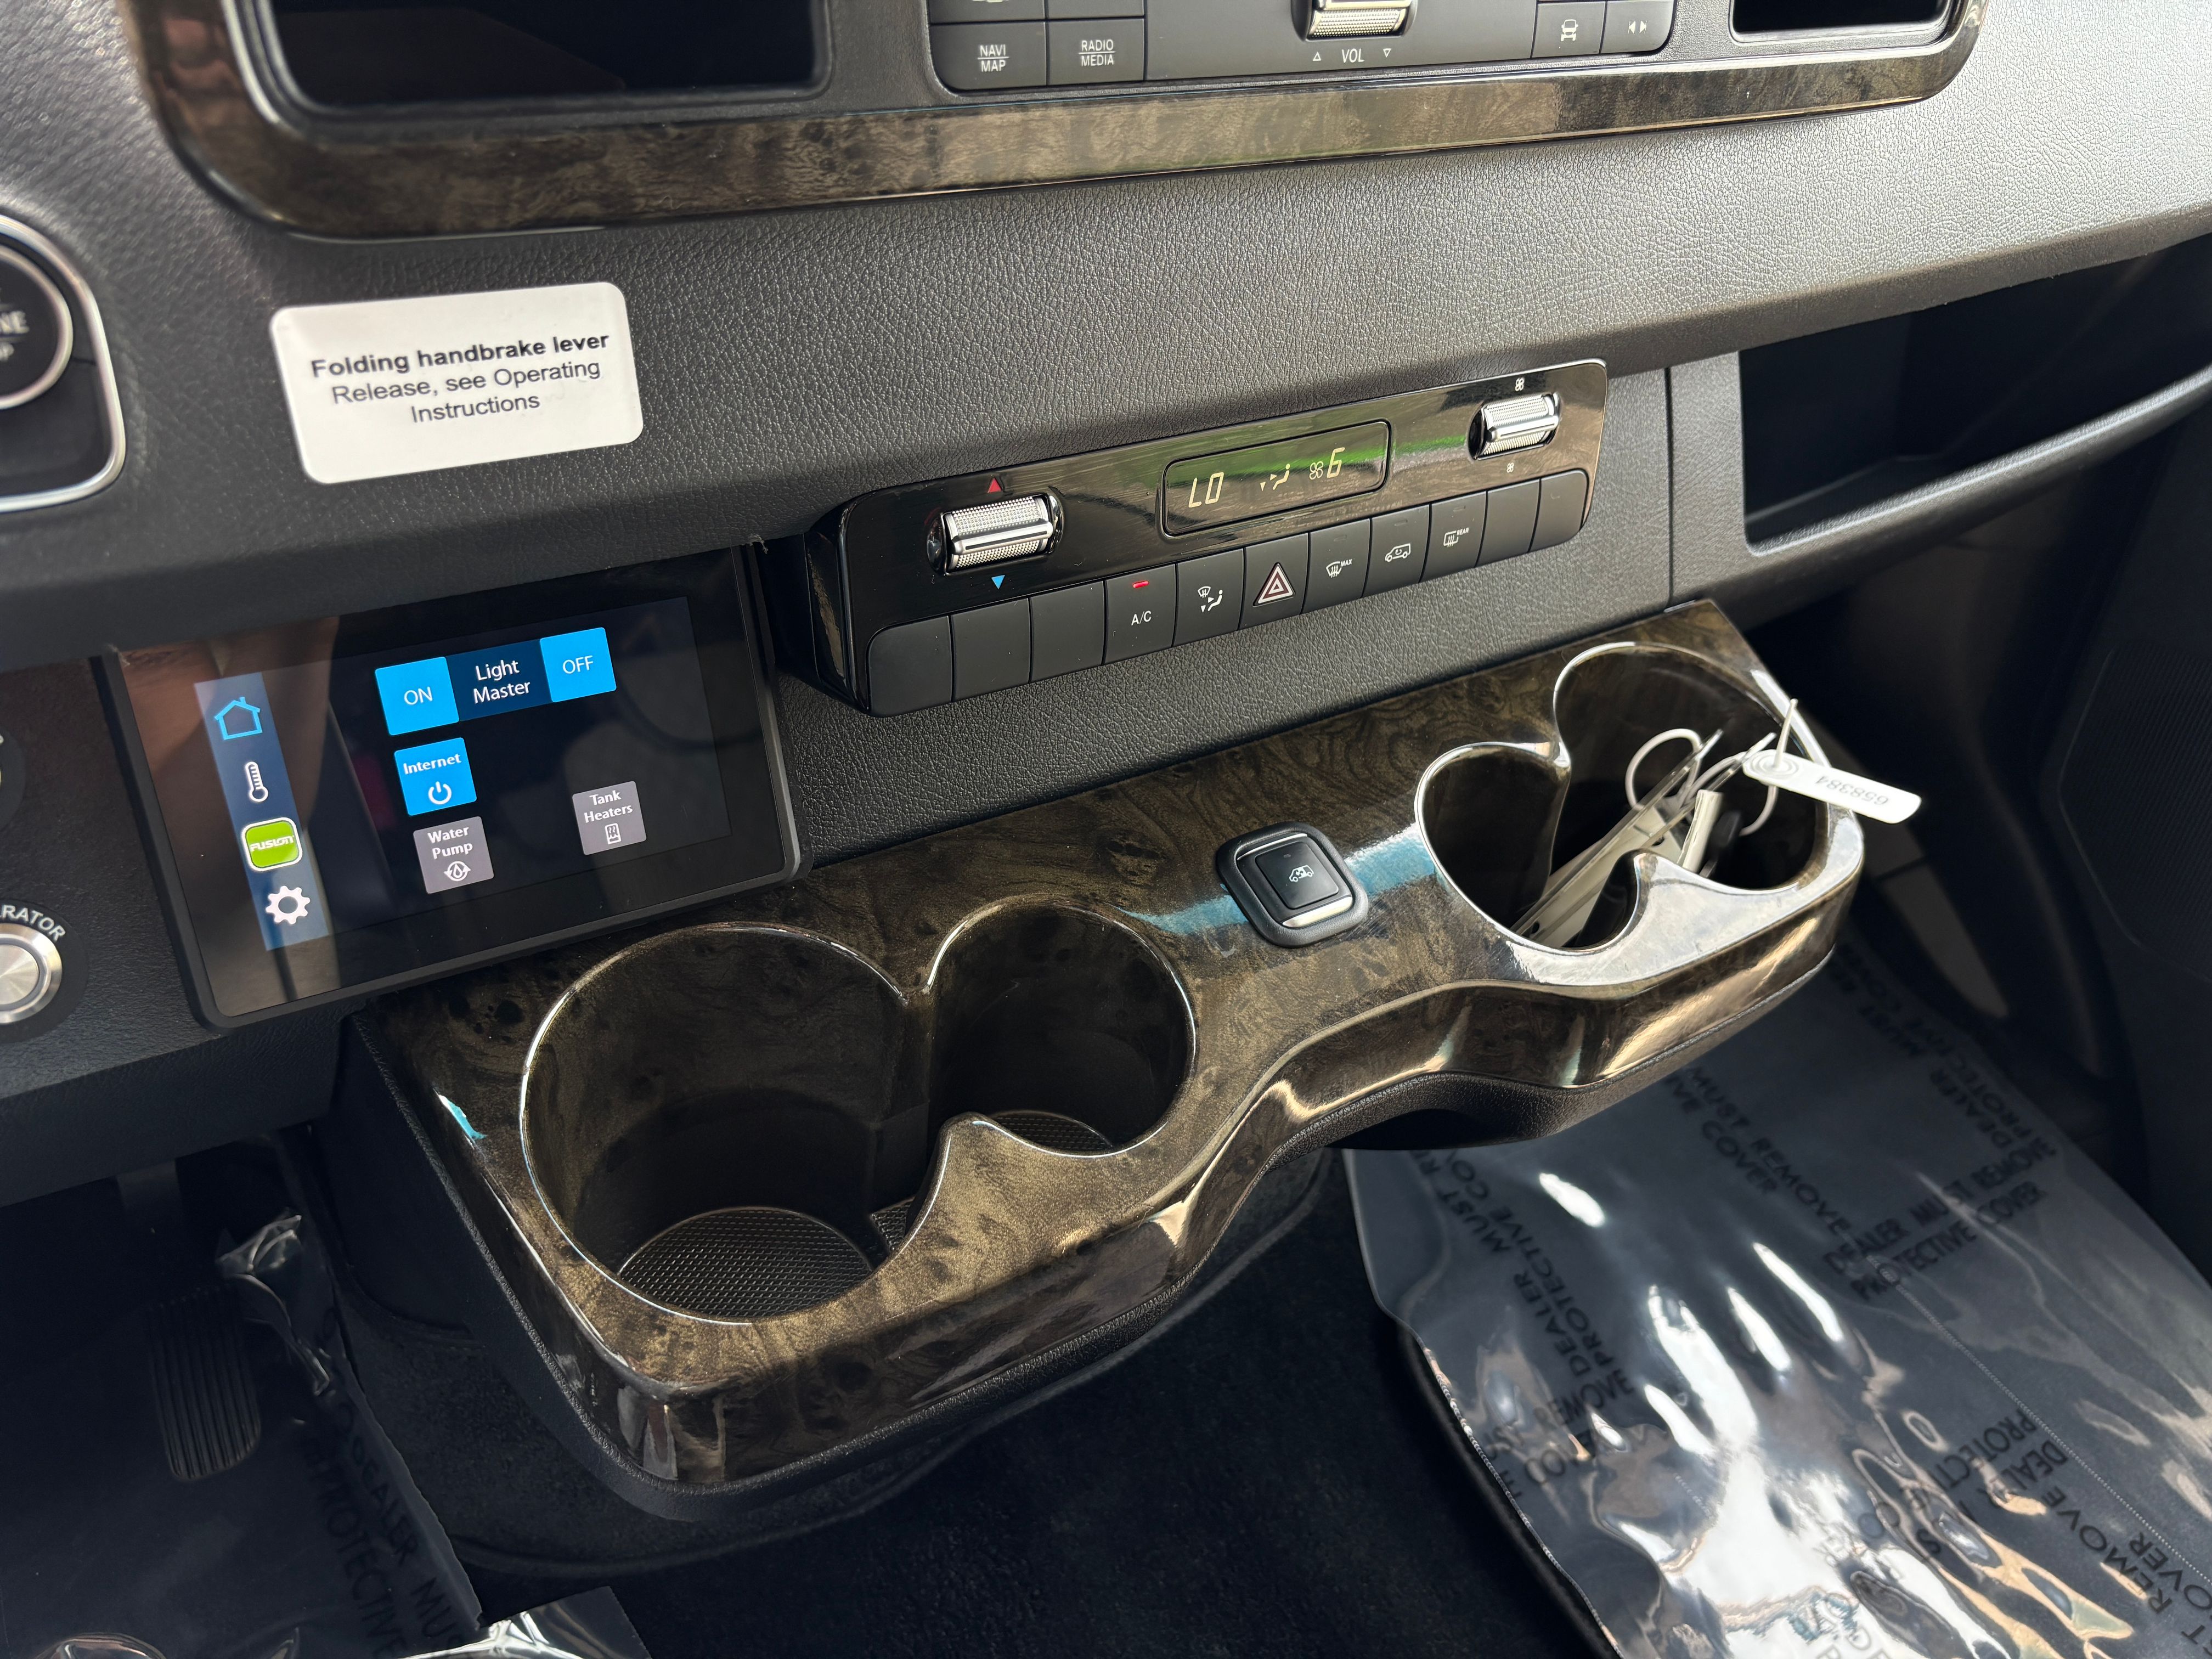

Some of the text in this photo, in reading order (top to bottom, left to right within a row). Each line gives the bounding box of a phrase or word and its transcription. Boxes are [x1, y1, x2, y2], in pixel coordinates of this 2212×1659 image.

[979, 44, 1006, 57] NAVI
[1081, 39, 1114, 52] RADIO
[981, 60, 1006, 72] MAP
[1081, 54, 1114, 66] MEDIA
[1341, 48, 1365, 64] VOL
[311, 333, 610, 379] Folding handbrake lever
[331, 360, 602, 405] Release, see Operating
[411, 392, 541, 424] Instructions
[1326, 447, 1346, 479] 6
[1188, 471, 1225, 509] LO
[1457, 527, 1470, 536] REAR
[1339, 558, 1353, 567] MAX
[1131, 610, 1152, 625] A/C
[475, 659, 520, 682] Light
[561, 655, 594, 676] OFF
[403, 686, 433, 706] ON
[472, 679, 531, 705] Master
[403, 751, 462, 776] Internet
[589, 789, 622, 806] Tank
[583, 803, 633, 823] Heaters
[250, 833, 295, 852] FUSION
[427, 824, 470, 844] Water
[431, 840, 473, 860] Pump
[0, 904, 66, 942] RATOR
[1489, 1207, 1615, 1368] PROTECTIVE
[1513, 1271, 1592, 1376] DEALER
[2129, 1532, 2212, 1610] OVER
